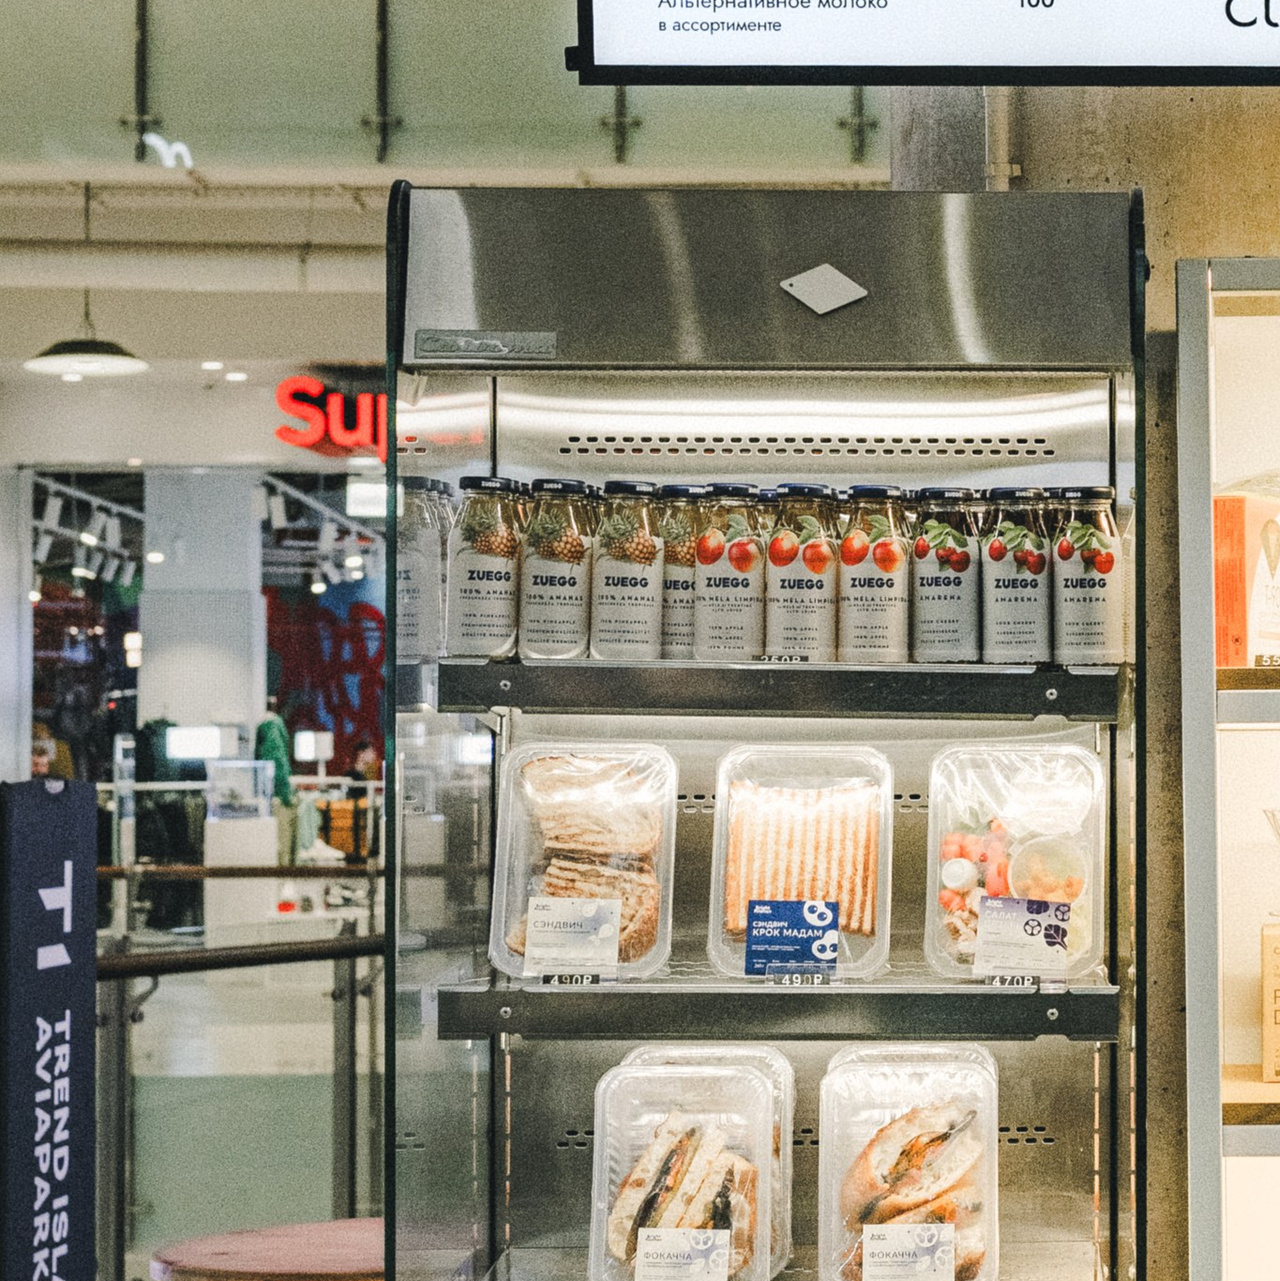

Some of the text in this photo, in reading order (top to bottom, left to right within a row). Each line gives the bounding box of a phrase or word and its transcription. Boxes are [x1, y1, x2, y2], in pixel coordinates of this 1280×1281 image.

[658, 21, 782, 35] в ассортименте
[467, 570, 512, 582] ZUEGG
[919, 576, 962, 587] ZUEGG
[604, 576, 649, 588] ZUEGG
[850, 577, 895, 589] ZUEGG
[1063, 578, 1107, 589] ZUEGG
[752, 920, 788, 928] СЭНДВИЧ
[752, 928, 823, 938] КРОК МАДАМ
[53, 1010, 72, 1182] TREND
[643, 1251, 693, 1262] ФОКАЧЧА
[869, 1250, 918, 1260] ФОКАЧЧА
